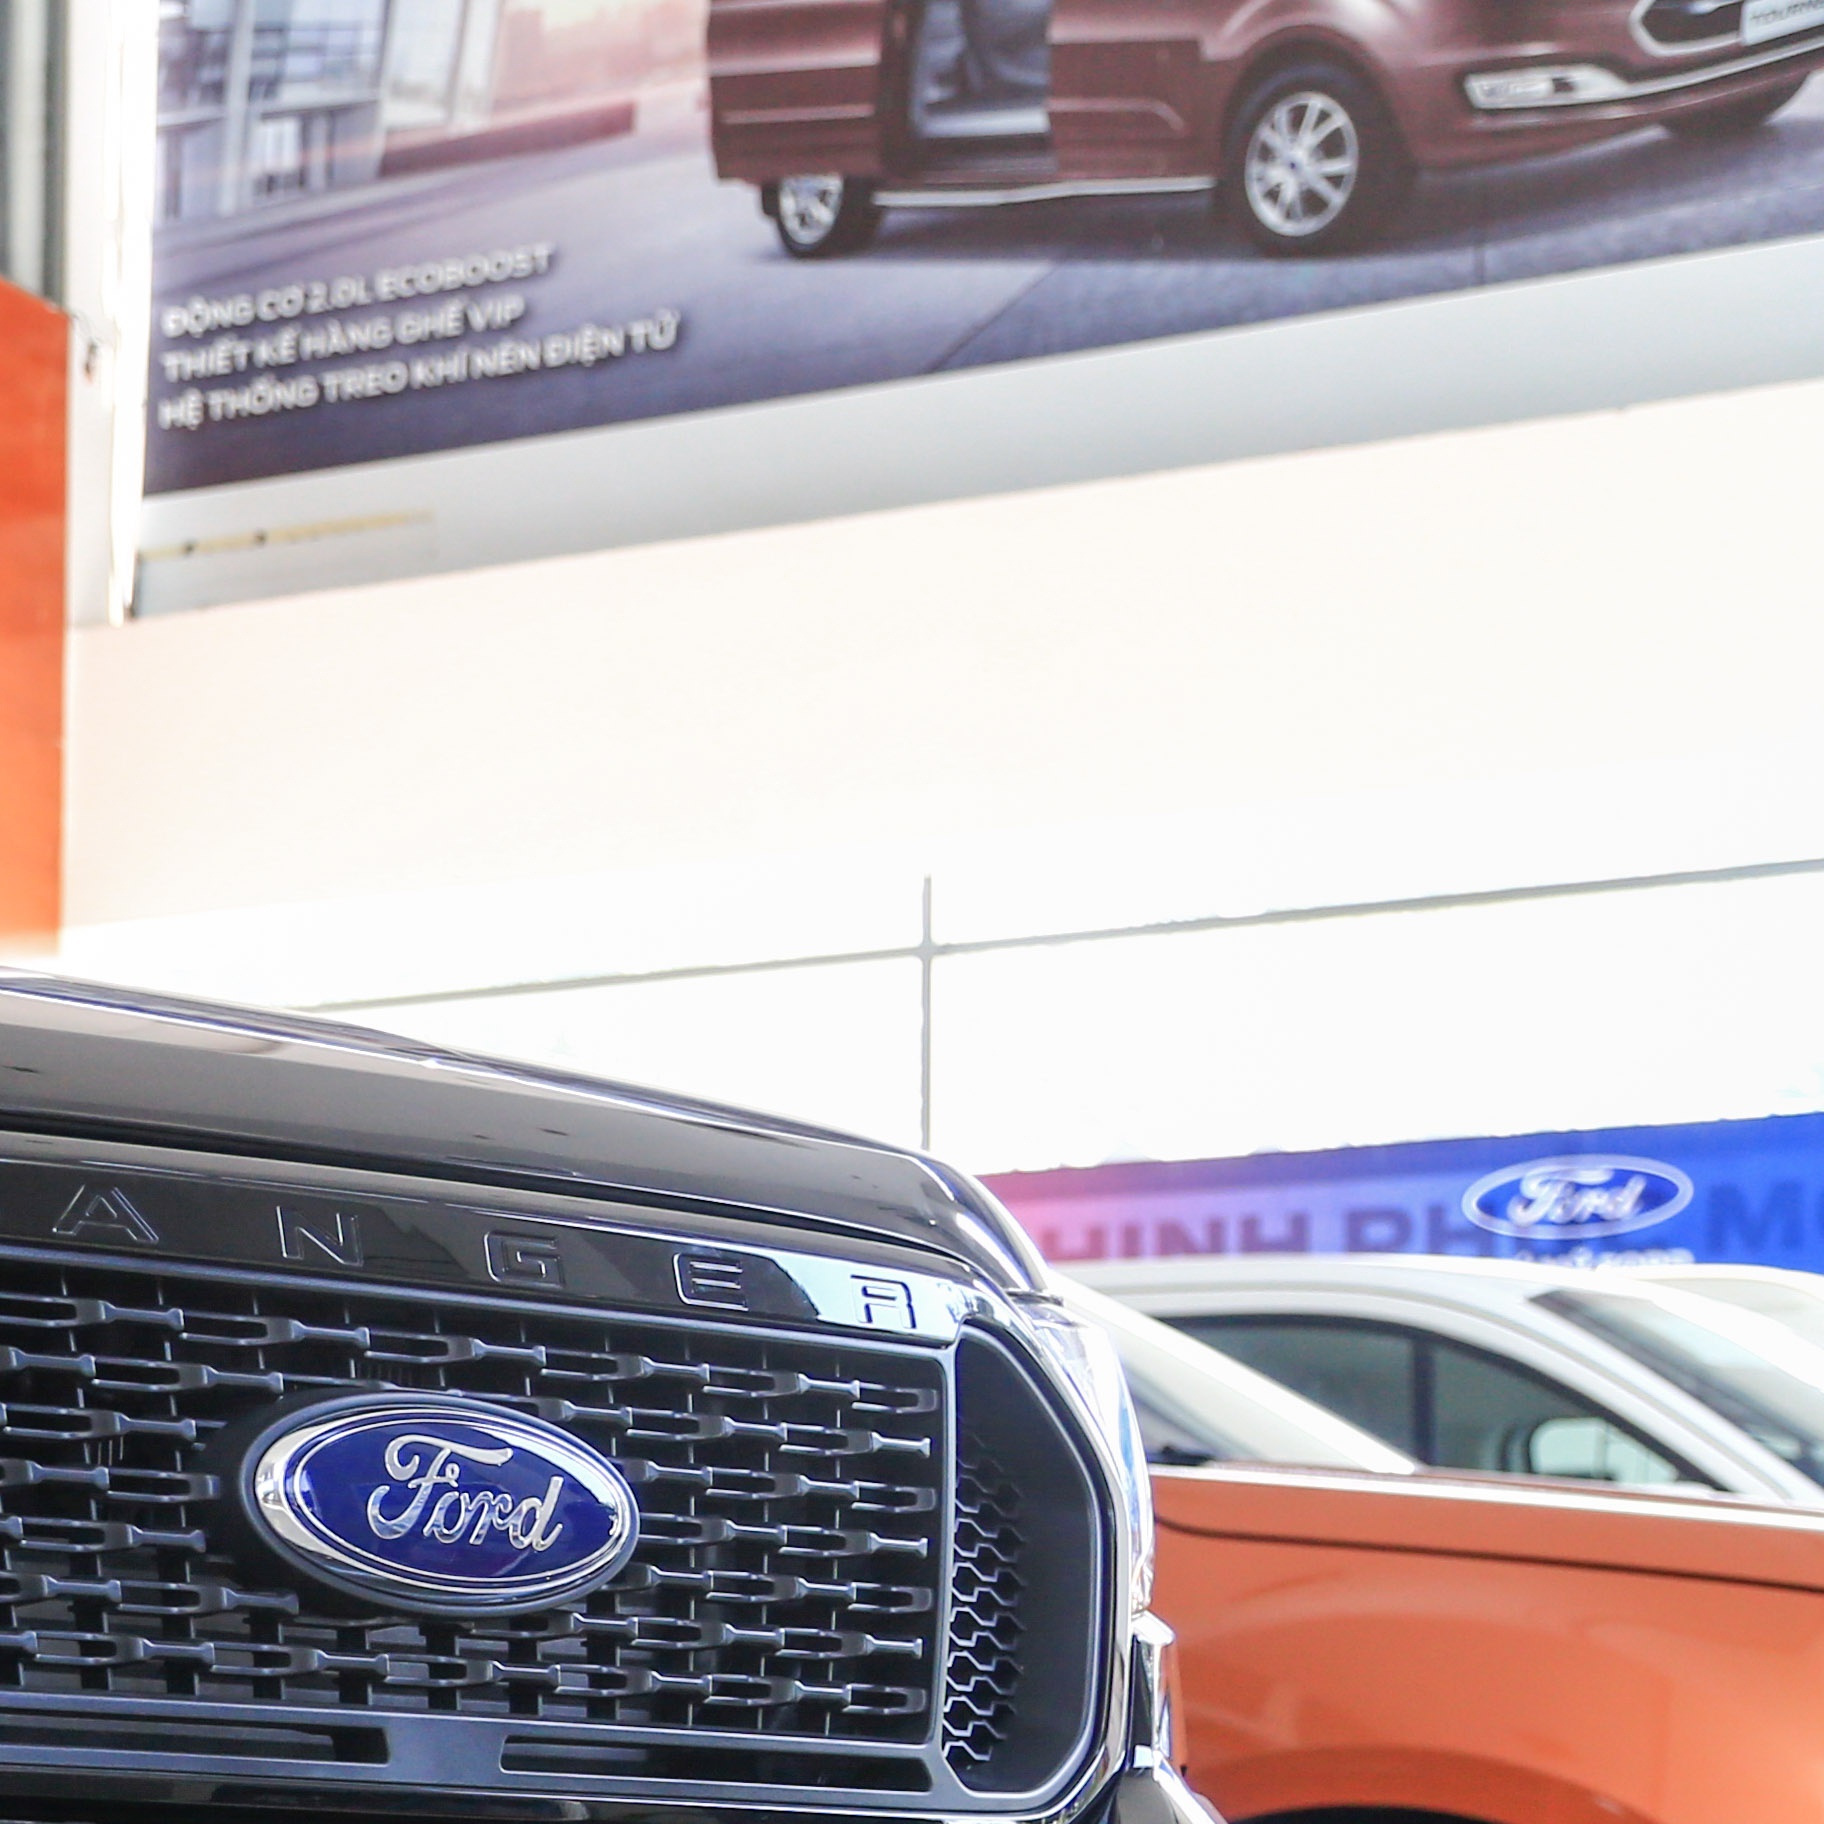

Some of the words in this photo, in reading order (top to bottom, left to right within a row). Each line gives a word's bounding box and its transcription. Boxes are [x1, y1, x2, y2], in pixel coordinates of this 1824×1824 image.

[374, 242, 555, 301] ECOBOOST
[466, 295, 525, 332] VIP
[319, 361, 408, 403] TREO
[1506, 1166, 1648, 1228] Ford
[366, 1433, 565, 1552] Ford
